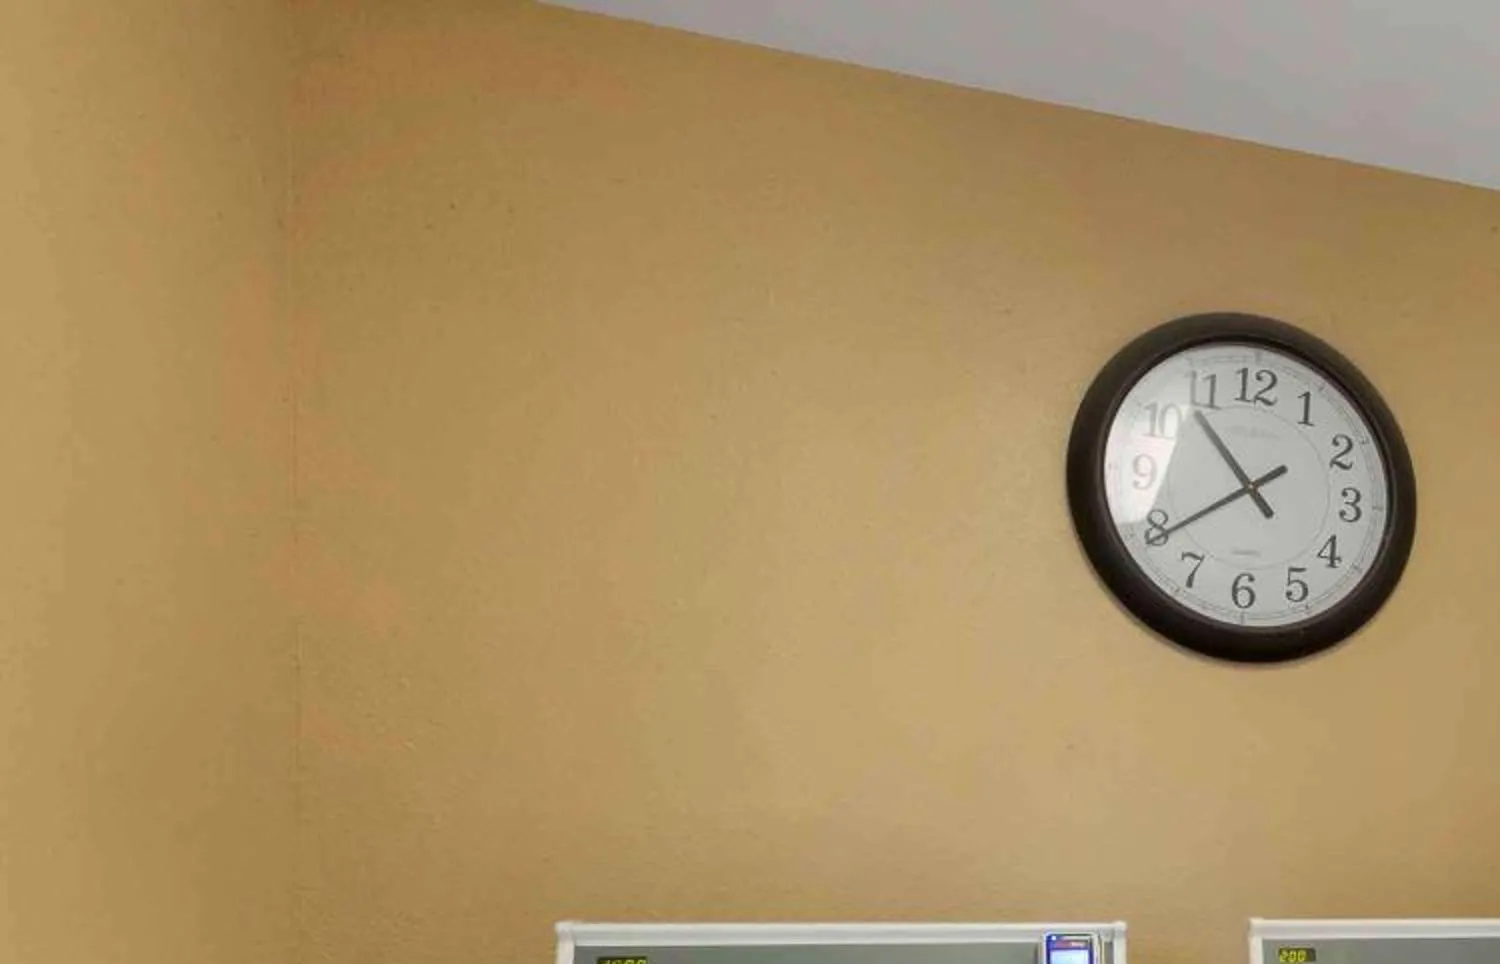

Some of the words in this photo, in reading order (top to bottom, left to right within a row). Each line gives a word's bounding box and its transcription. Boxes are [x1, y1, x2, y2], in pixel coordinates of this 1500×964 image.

[1186, 370, 1221, 410] 11
[1234, 367, 1278, 407] 12
[1297, 391, 1315, 427] 1
[1329, 434, 1354, 470] 2
[1132, 454, 1157, 490] 9
[1339, 487, 1362, 523] 3
[1144, 508, 1169, 547] 8
[1181, 551, 1205, 588] 7
[1317, 534, 1342, 569] 4
[1231, 573, 1256, 609] 6
[1285, 567, 1309, 602] 5
